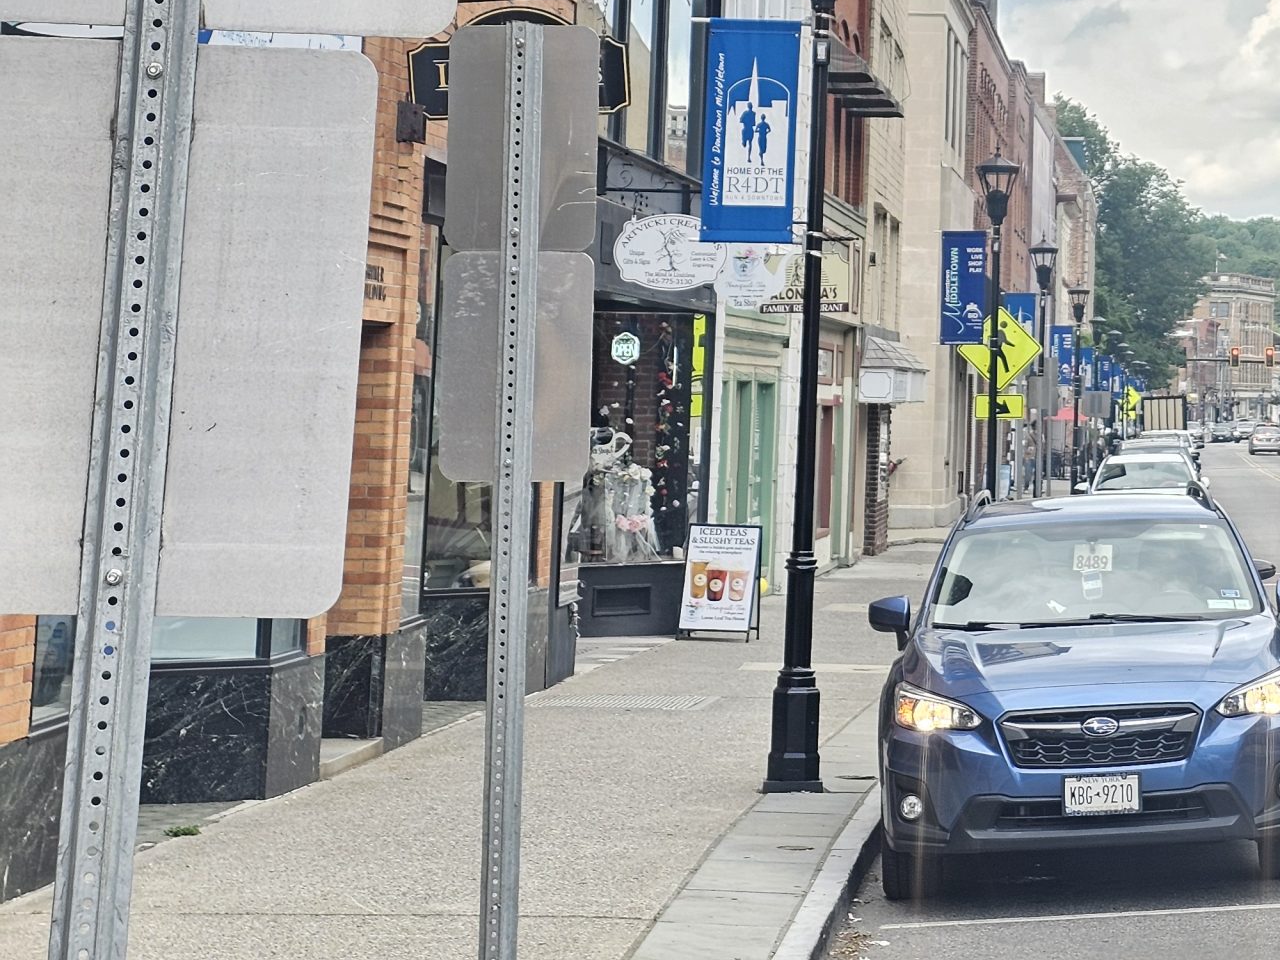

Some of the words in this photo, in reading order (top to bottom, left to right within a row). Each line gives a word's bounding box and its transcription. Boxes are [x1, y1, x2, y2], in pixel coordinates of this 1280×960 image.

[712, 110, 722, 154] Downtown
[711, 156, 721, 166] to
[768, 167, 784, 175] THE
[710, 170, 720, 206] Welcome
[726, 177, 784, 194] R4DT
[622, 218, 666, 248] ARTVICKI
[770, 287, 837, 301] ALONA'S
[943, 248, 964, 334] MIDDLETOWN
[763, 304, 791, 313] FAMILY
[793, 304, 843, 313] RERANT
[616, 344, 633, 356] OPEN
[1076, 555, 1108, 569] 8489
